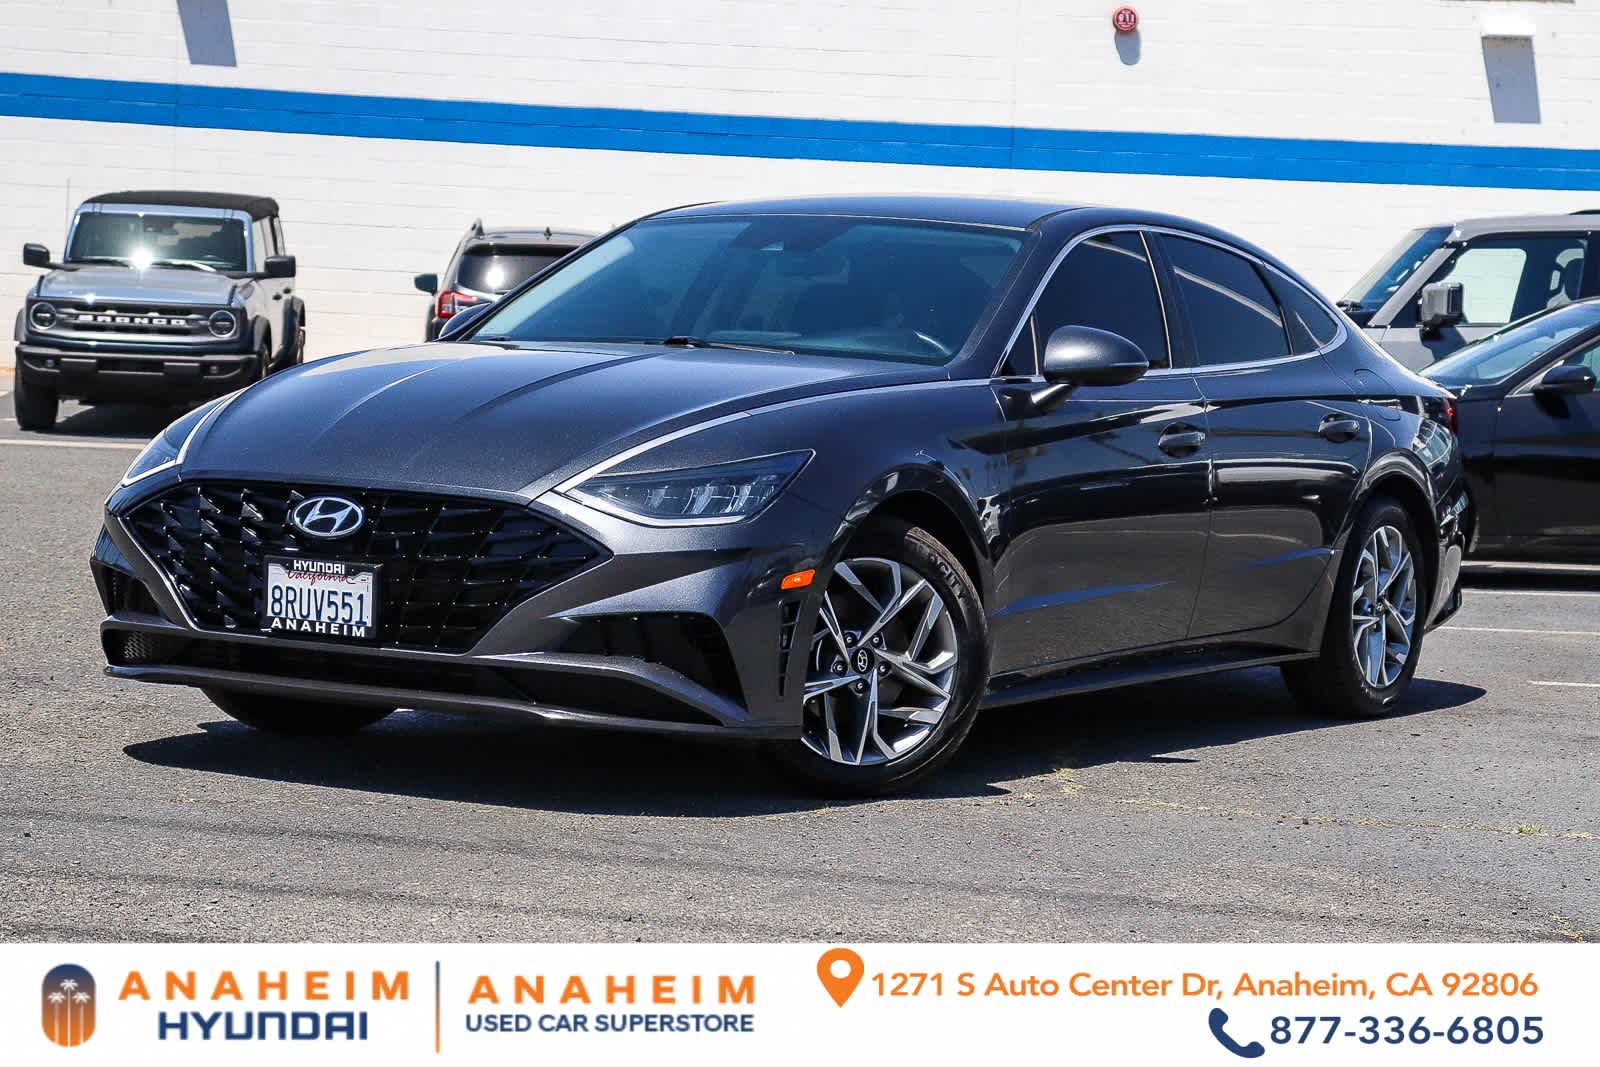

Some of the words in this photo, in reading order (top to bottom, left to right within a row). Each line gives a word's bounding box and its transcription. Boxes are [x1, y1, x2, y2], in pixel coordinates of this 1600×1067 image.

[78, 314, 187, 326] BRONCO
[293, 559, 345, 575] HYUNDAI
[271, 584, 368, 626] 8RUV551
[271, 617, 366, 638] ANAHEIM
